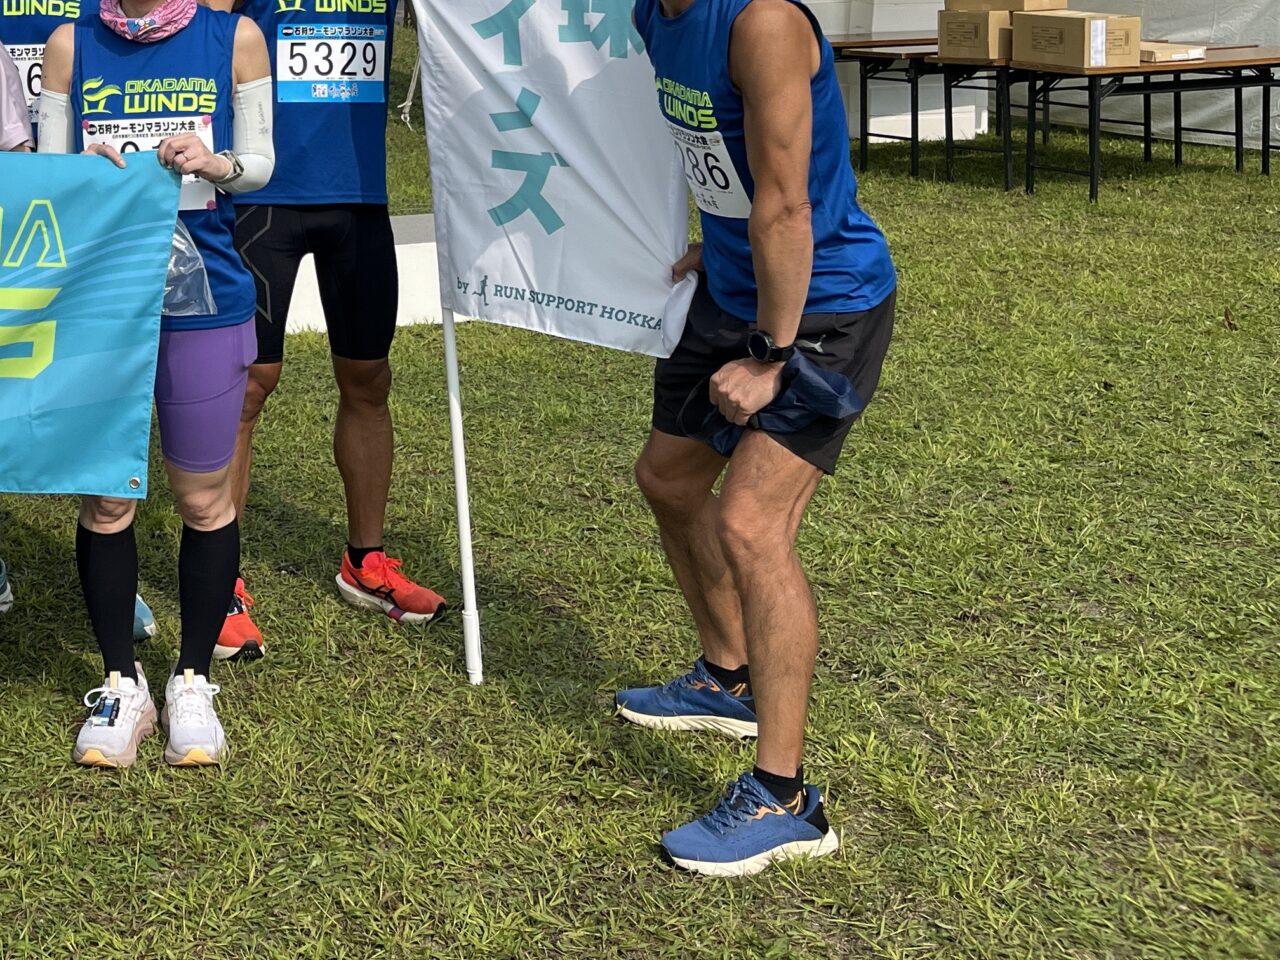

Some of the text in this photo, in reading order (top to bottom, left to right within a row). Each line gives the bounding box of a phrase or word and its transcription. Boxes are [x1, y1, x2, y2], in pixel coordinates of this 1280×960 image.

[3, 0, 81, 19] WINDS
[288, 42, 376, 76] 5329
[124, 77, 217, 94] OKADAMA
[124, 92, 217, 114] WINDS
[664, 94, 718, 128] WINDS
[98, 120, 196, 135] 石狩サーモンマラソン大会
[457, 276, 662, 330] by RUN SUPPORT HOKKA
